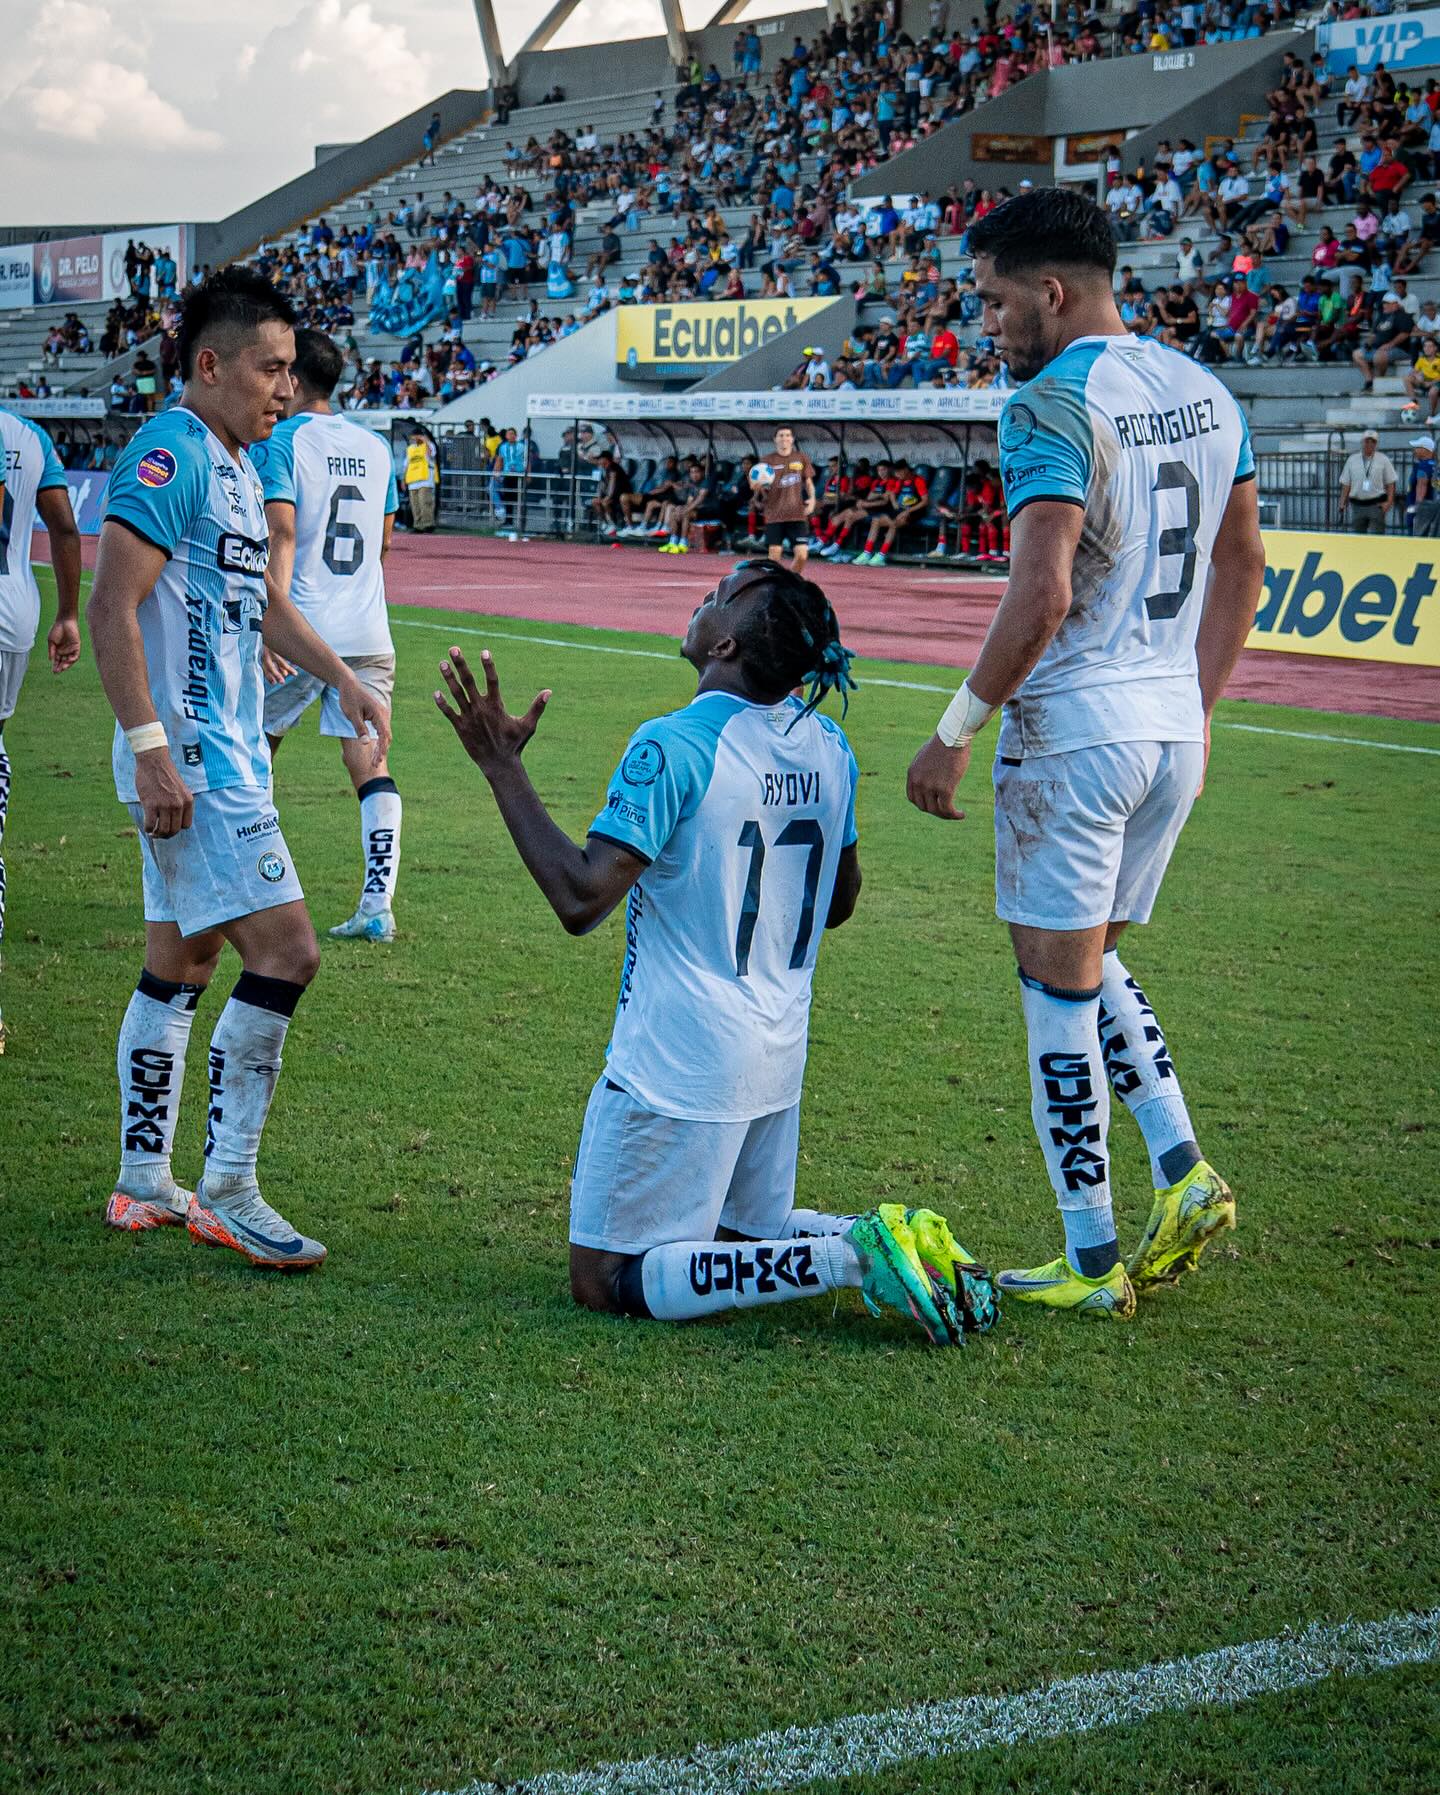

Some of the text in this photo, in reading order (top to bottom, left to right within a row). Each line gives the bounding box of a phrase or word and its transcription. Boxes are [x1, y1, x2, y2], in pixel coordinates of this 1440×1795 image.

[1355, 21, 1424, 65] VIP
[75, 254, 99, 274] PELO
[322, 484, 366, 575] 6
[1144, 461, 1200, 620] 3
[182, 593, 210, 725] Fibramax
[620, 803, 647, 824] Piña
[763, 771, 820, 806] AYOVI
[735, 819, 825, 977] 17
[126, 1048, 175, 1154] GUTMAN
[1039, 1052, 1106, 1192] GUTMAN
[690, 1245, 820, 1296] GUTMAN
